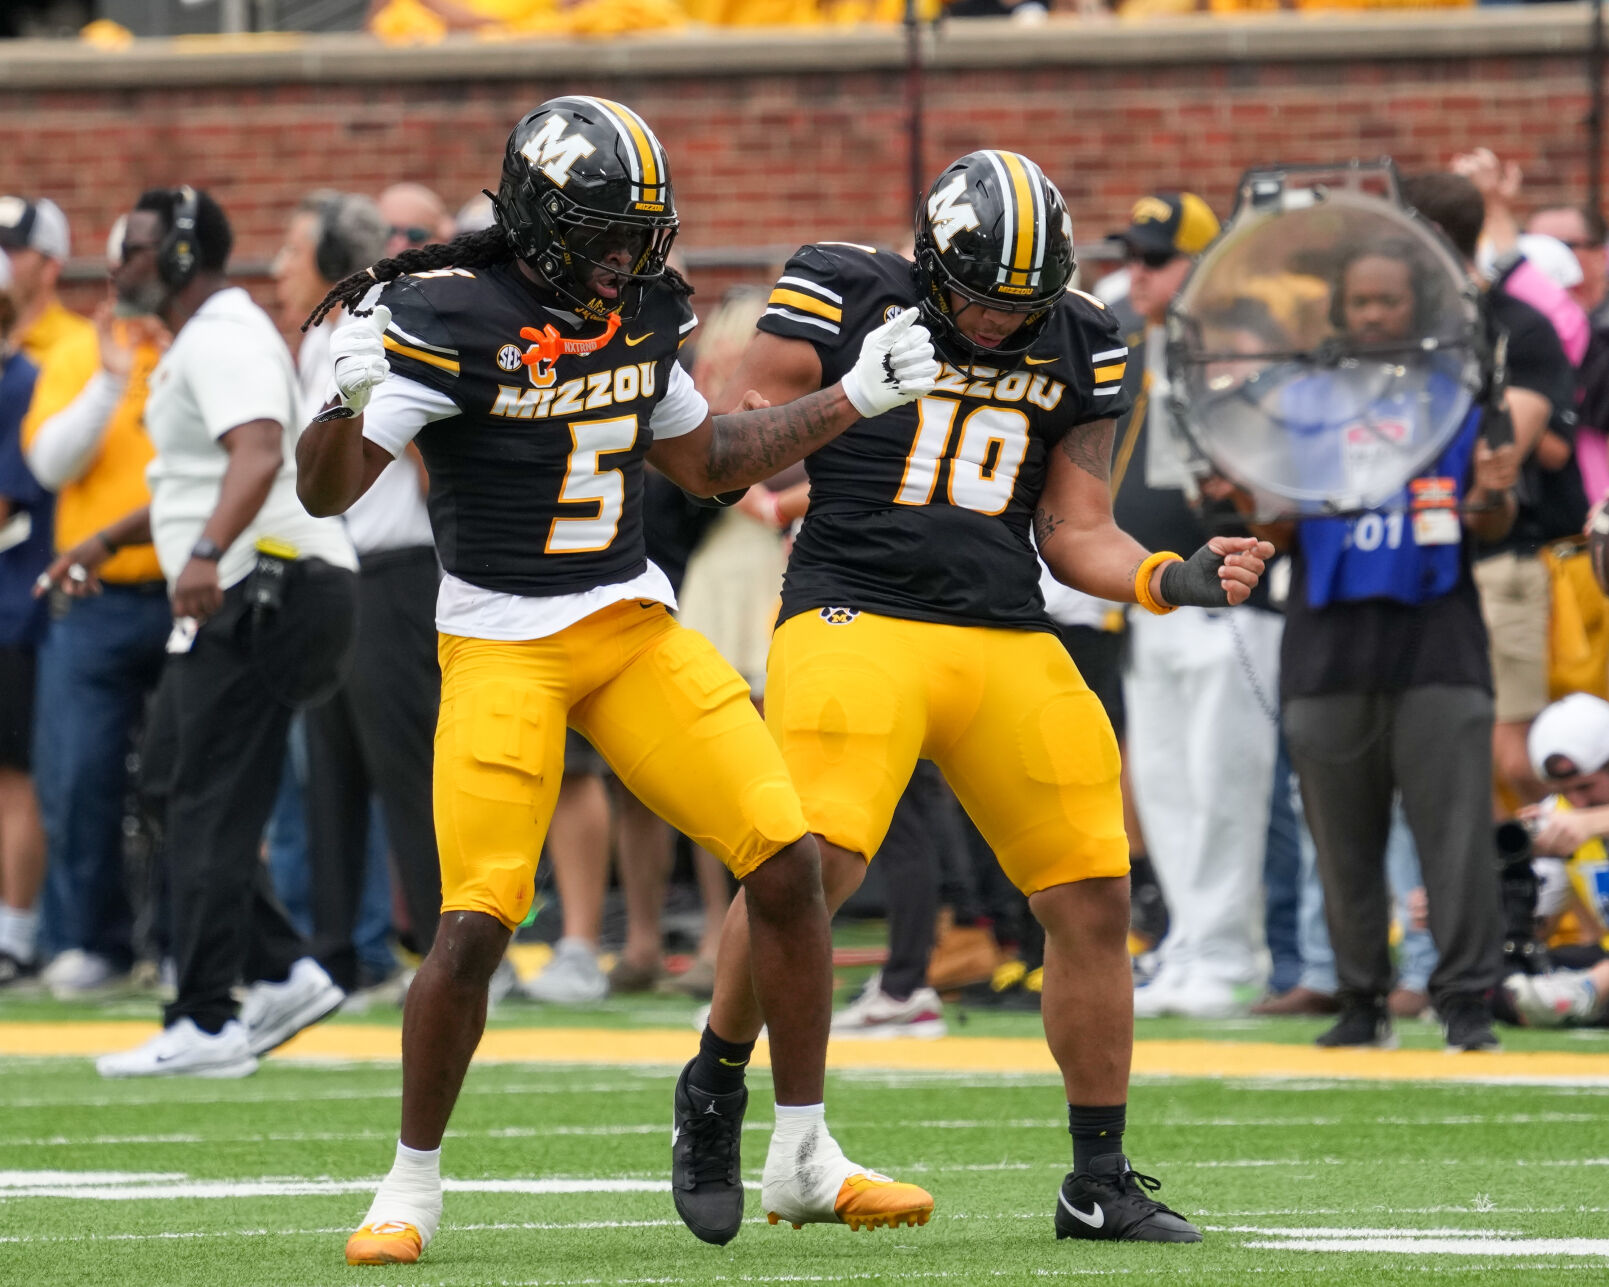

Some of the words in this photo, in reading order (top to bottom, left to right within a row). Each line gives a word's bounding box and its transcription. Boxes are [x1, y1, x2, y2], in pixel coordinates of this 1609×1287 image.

[520, 113, 597, 189] M
[634, 202, 664, 212] MIZZOU
[927, 173, 981, 254] M
[997, 285, 1033, 296] MIZZOU
[499, 346, 521, 370] SEC
[564, 341, 598, 353] NXTRND
[489, 361, 657, 419] MIZZOU
[930, 361, 1067, 411] ZZOU
[892, 395, 1030, 516] 10
[544, 413, 638, 554] 5
[831, 614, 848, 623] M
